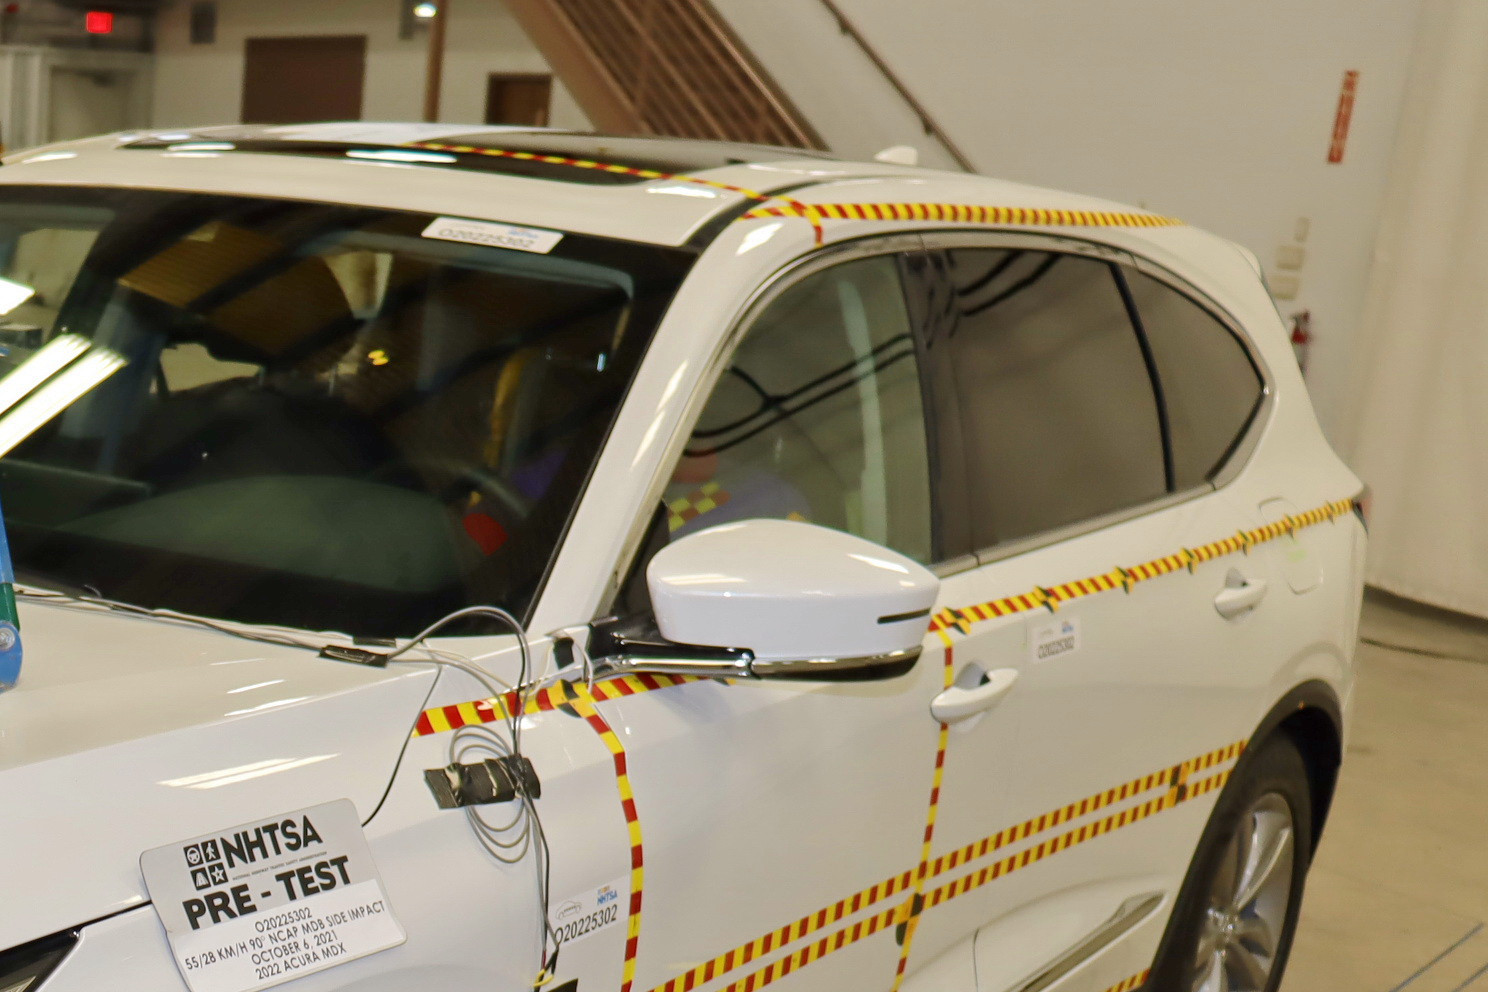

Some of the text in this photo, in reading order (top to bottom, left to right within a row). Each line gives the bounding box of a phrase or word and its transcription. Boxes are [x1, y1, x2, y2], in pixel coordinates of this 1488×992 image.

[220, 815, 323, 869] NHTSA
[182, 883, 258, 931] PRE
[275, 855, 351, 901] TEST
[185, 951, 216, 970] 55/28
[217, 941, 248, 960] KM/H
[268, 926, 298, 944] NCAP
[301, 919, 325, 935] MDB
[325, 912, 348, 927] SIDE
[347, 900, 385, 920] IMPACT
[251, 929, 338, 965] OCTOBER 6, 2021
[255, 942, 347, 980] 2022 ACURA MDX
